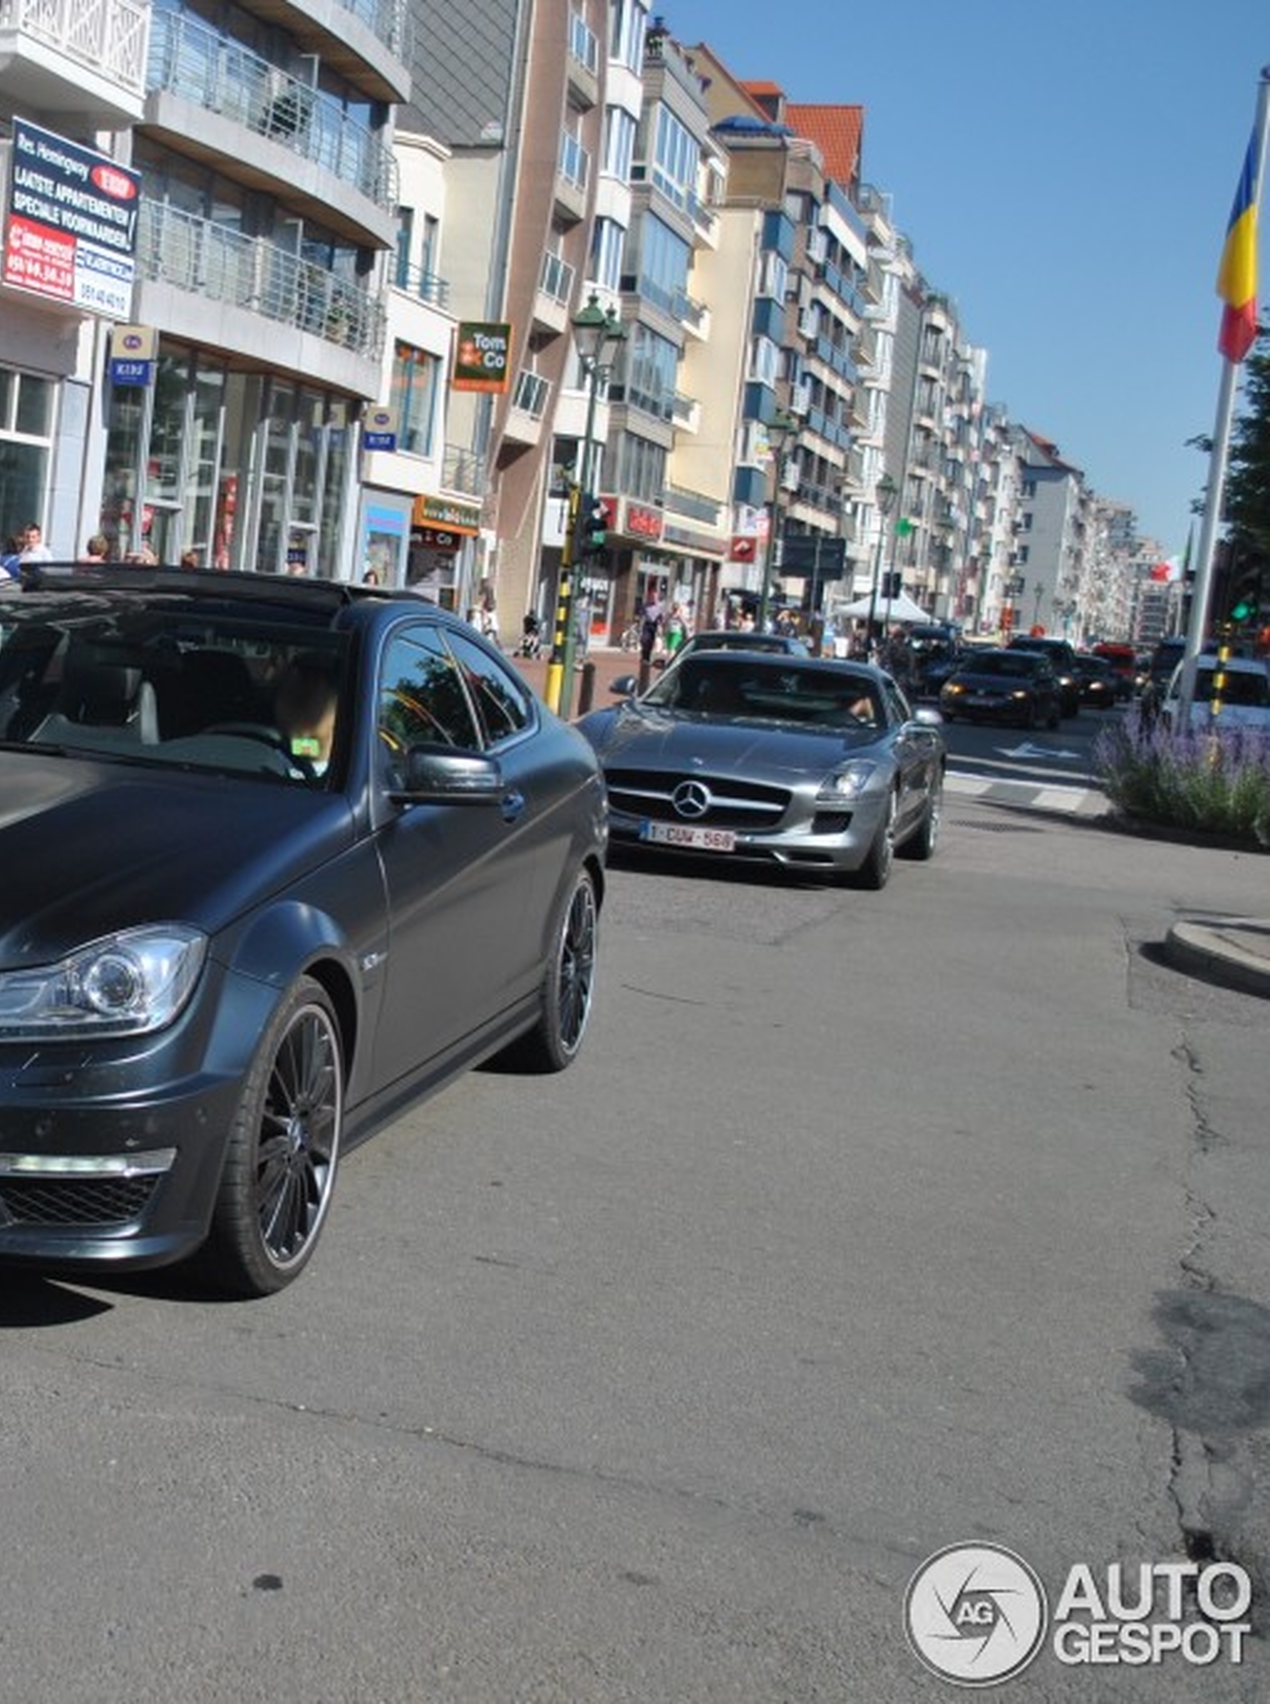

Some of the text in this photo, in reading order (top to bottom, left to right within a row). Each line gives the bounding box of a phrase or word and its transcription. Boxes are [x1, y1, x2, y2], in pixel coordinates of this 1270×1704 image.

[14, 165, 54, 198] LAATSTE
[473, 332, 506, 350] Tom
[483, 351, 505, 369] Co
